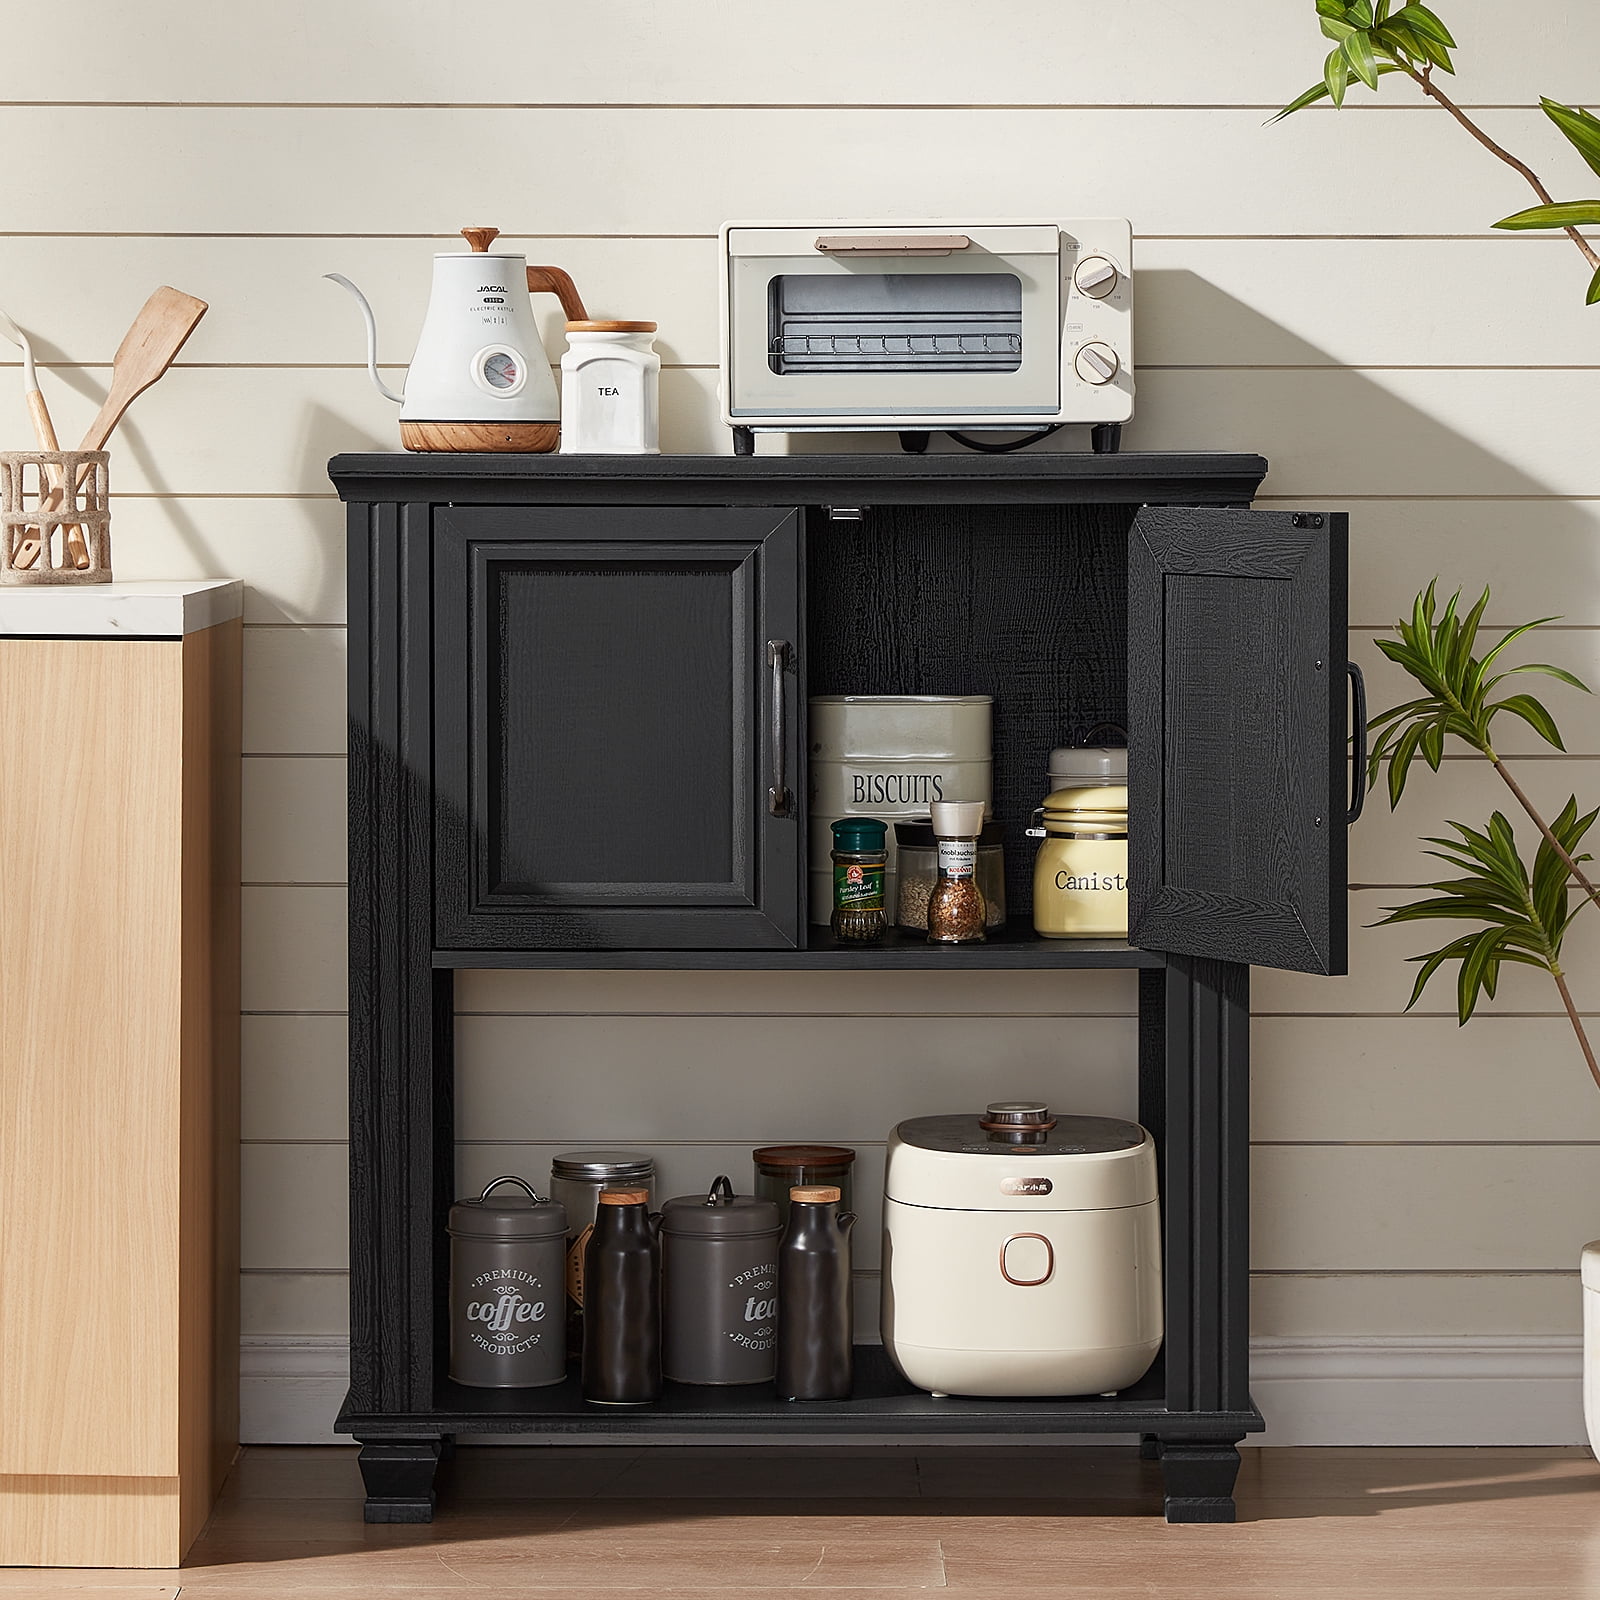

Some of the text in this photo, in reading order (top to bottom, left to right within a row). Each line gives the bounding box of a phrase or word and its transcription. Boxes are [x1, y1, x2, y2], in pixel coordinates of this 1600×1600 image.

[476, 285, 509, 293] JACAL
[597, 387, 620, 396] TEA
[852, 774, 944, 804] BISCUITS
[475, 1269, 538, 1287] PREMIUM
[466, 1294, 546, 1331] coffee
[473, 1334, 539, 1355] PRODUCTS
